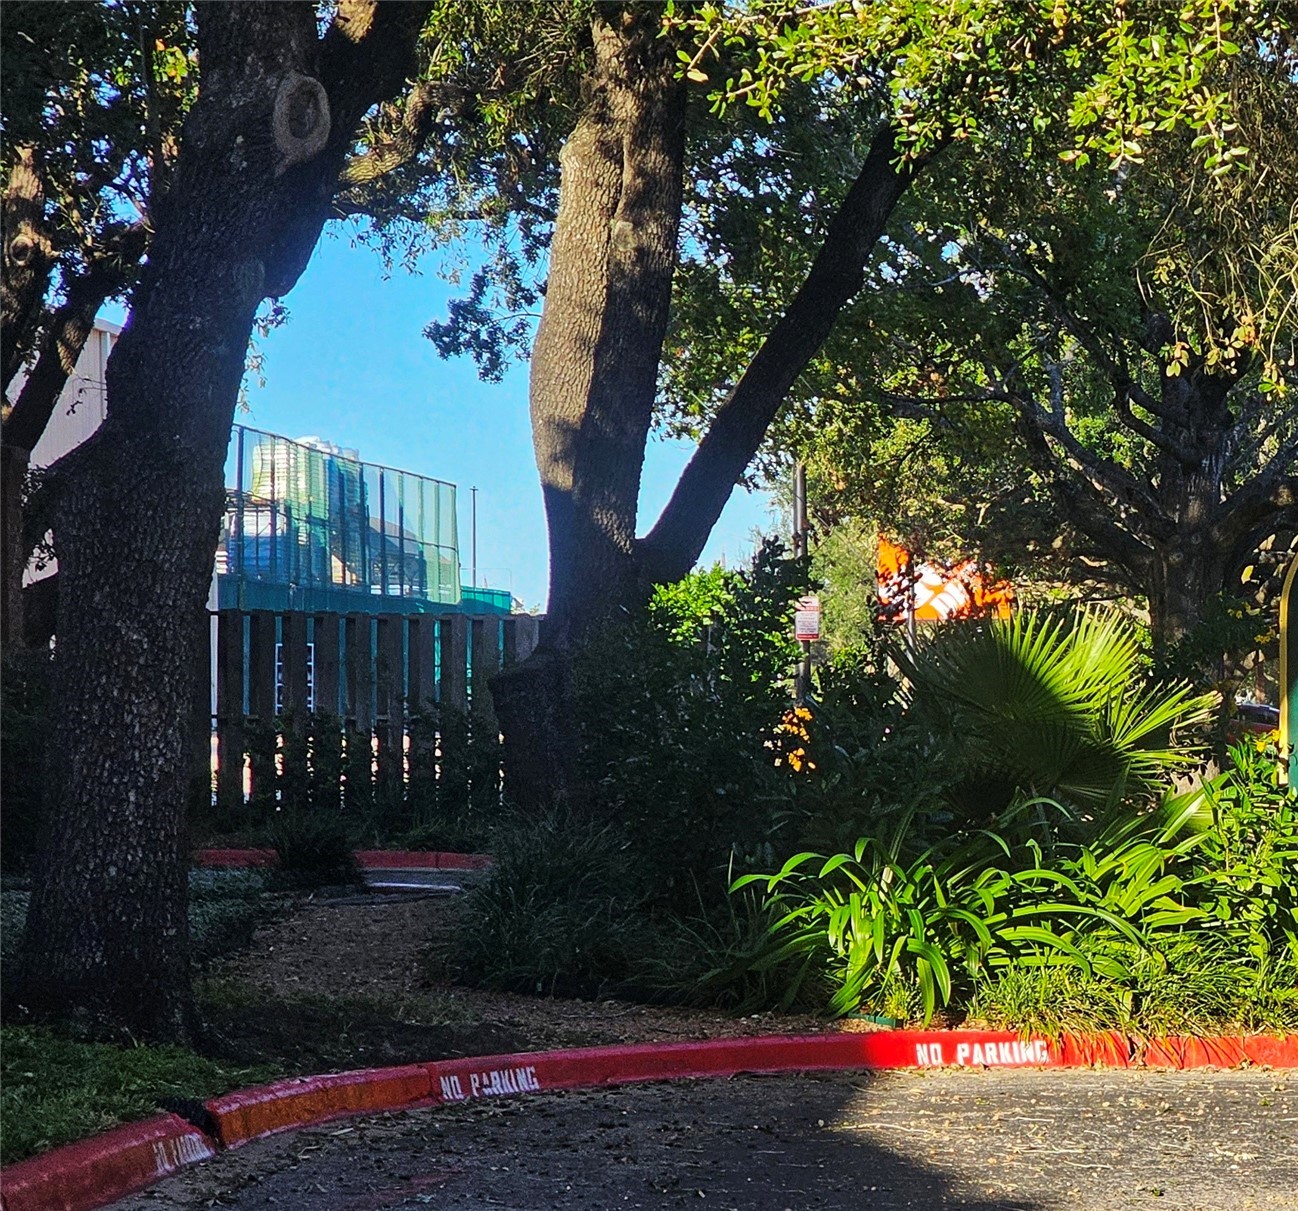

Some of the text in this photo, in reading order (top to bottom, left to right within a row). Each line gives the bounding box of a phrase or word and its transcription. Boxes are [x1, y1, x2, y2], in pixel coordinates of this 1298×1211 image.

[916, 1040, 1050, 1066] NO PARKING
[440, 1066, 539, 1100] NO PARKING
